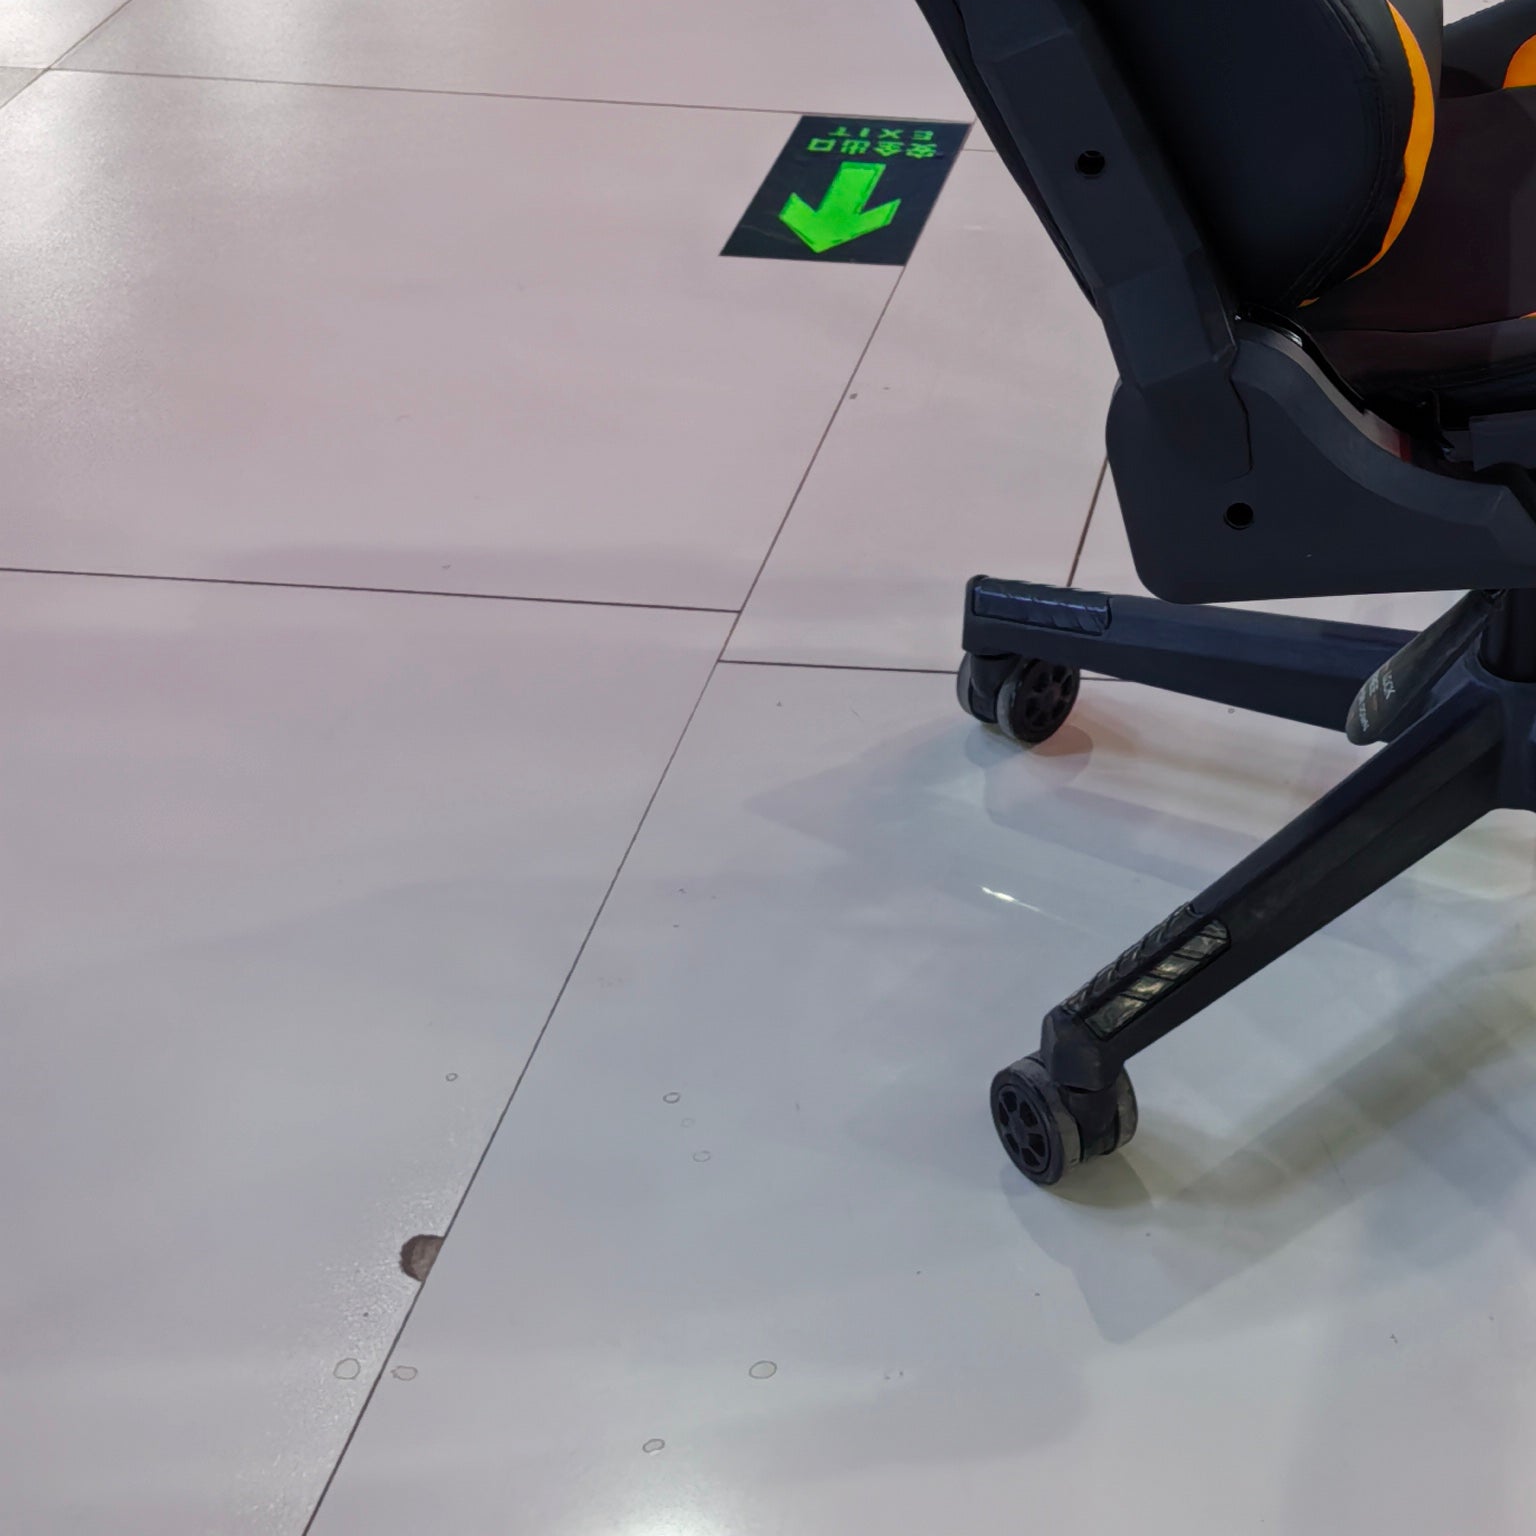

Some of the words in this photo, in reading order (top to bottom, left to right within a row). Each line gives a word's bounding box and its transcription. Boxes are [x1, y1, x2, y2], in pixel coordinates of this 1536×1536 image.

[828, 126, 934, 141] EXIT
[807, 137, 938, 159] 安全出口
